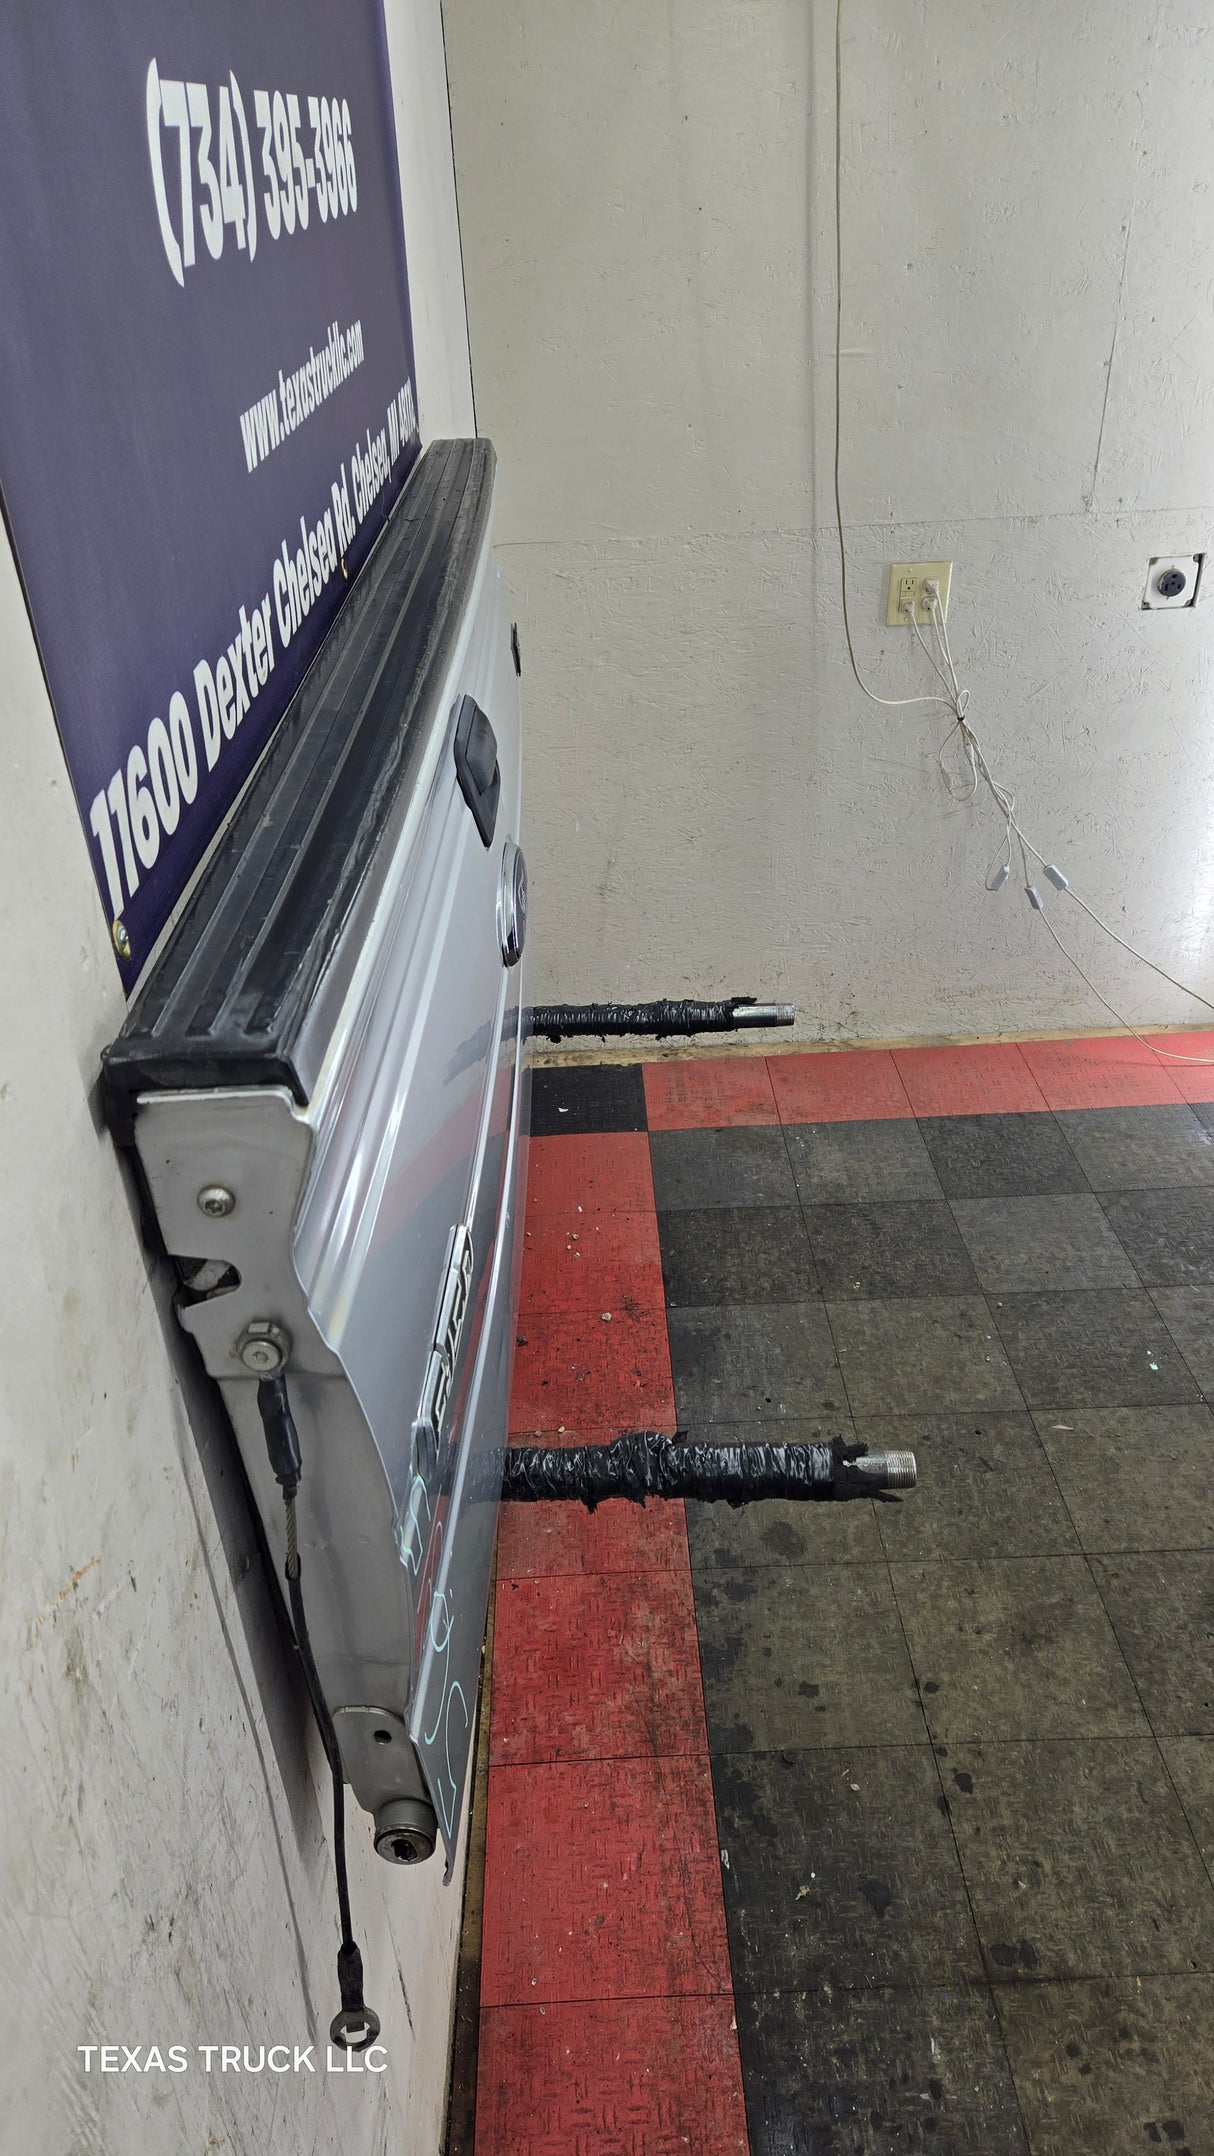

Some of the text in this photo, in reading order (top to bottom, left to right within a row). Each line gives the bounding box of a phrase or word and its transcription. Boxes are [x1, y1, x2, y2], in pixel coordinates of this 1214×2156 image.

[145, 57, 358, 288] (734) 395-3966
[239, 319, 365, 474] www.texastruckllc.com
[89, 690, 198, 919] 11600
[193, 604, 275, 772] Dexter
[273, 515, 338, 648] Chelsea
[330, 462, 356, 558] Rd.
[351, 427, 392, 525] Chelsea,
[386, 399, 400, 466] MI
